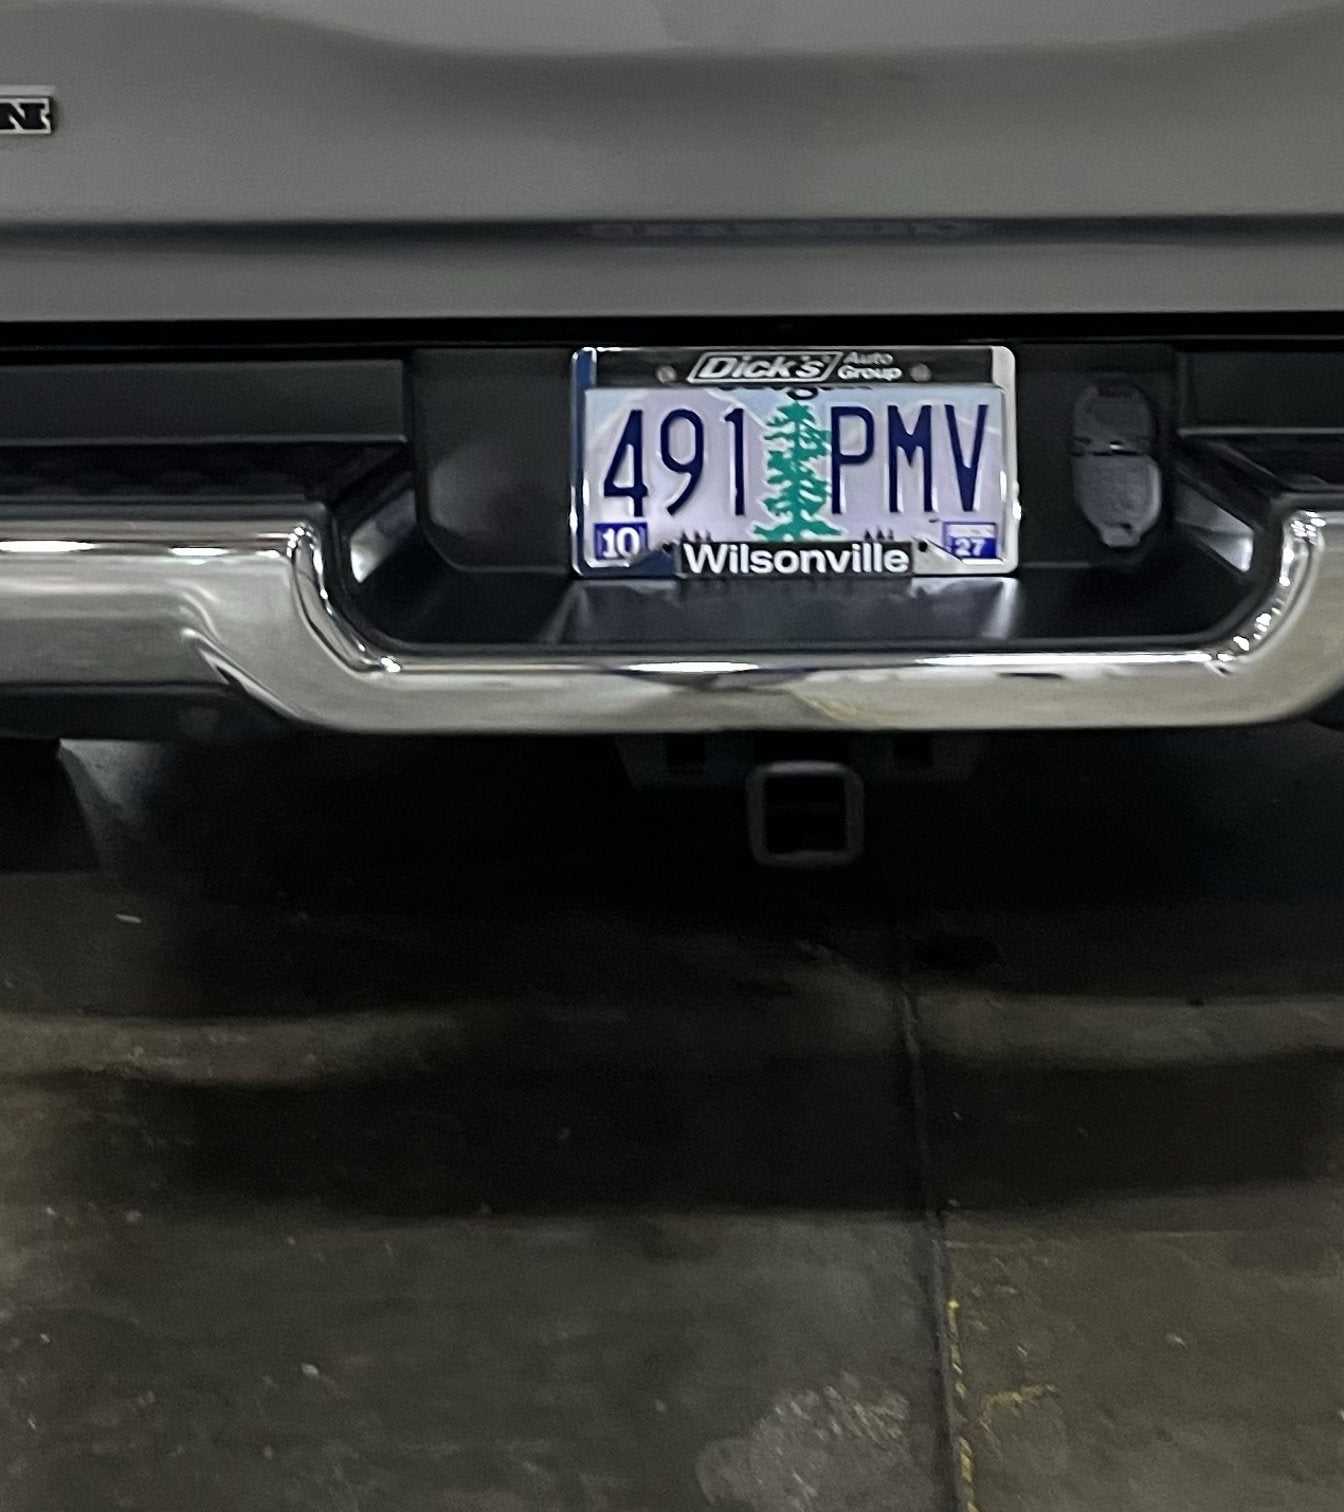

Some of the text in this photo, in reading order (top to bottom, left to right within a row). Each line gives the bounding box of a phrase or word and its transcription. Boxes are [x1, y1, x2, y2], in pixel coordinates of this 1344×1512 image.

[843, 351, 894, 367] Auto
[838, 364, 903, 382] Group
[602, 403, 989, 517] 491 PMV
[601, 528, 641, 556] 10
[954, 537, 986, 557] 27
[683, 543, 910, 574] Wilsonville
